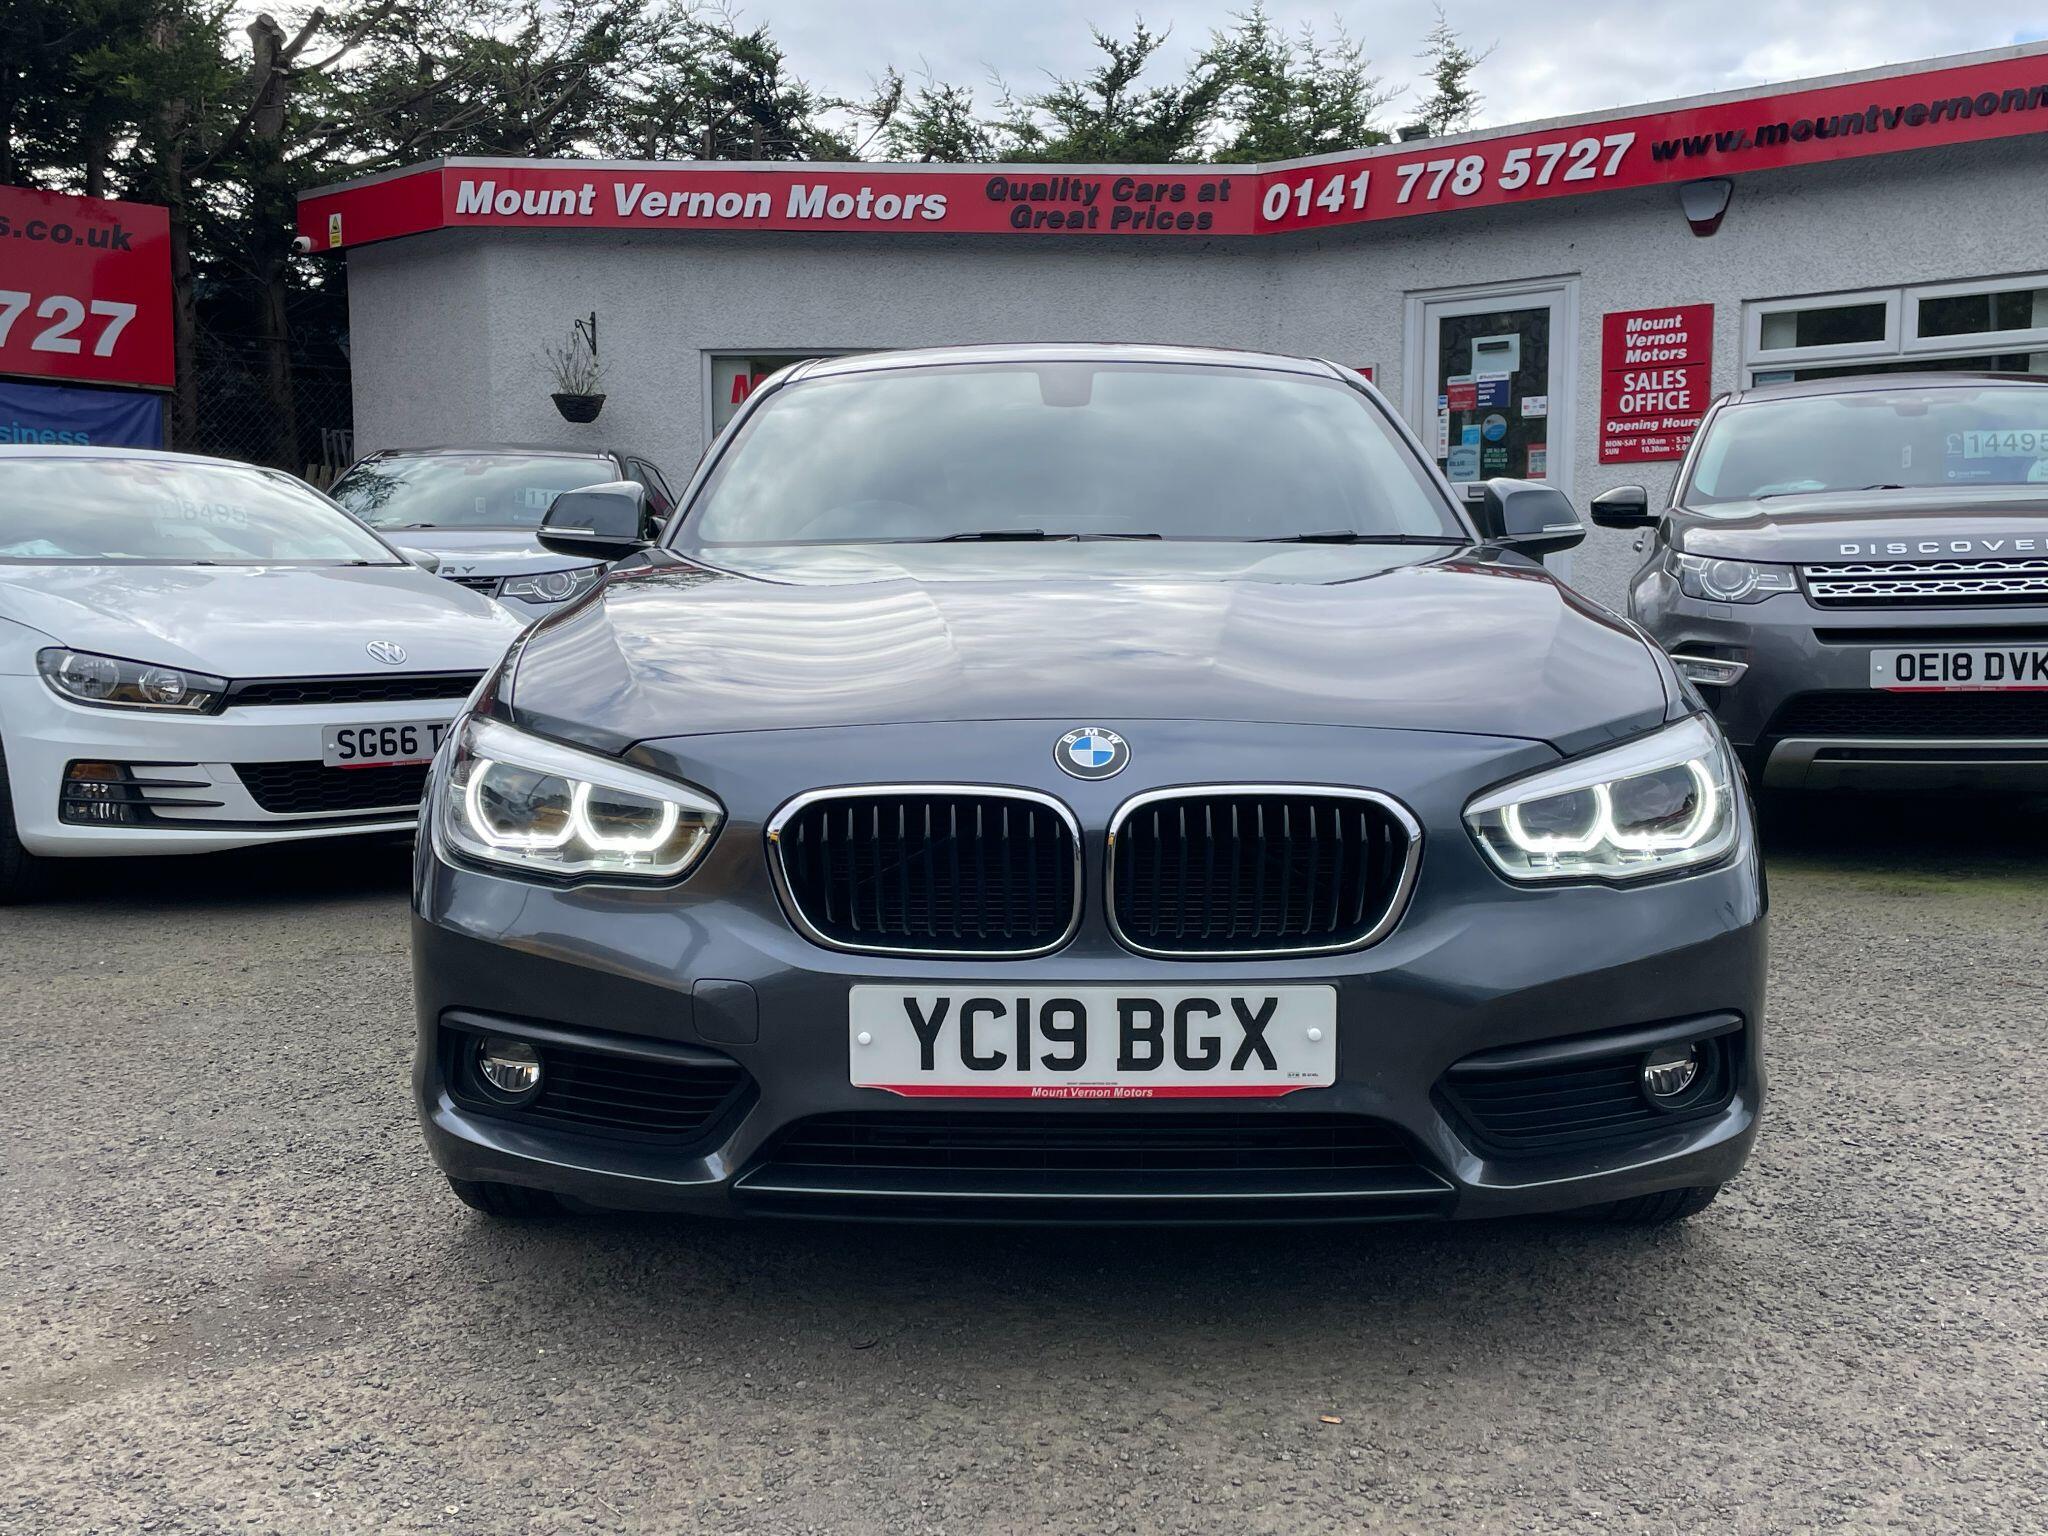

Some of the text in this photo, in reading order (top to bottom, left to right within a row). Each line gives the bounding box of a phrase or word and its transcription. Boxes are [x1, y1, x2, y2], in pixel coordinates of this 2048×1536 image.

[1262, 132, 1636, 222] 0141 778 5727
[455, 180, 948, 221] Mount Vernon Motors
[985, 176, 1231, 206] Quality Cars at
[1010, 204, 1213, 230] Great Prices
[0, 290, 137, 358] 727
[1626, 314, 1683, 332] Mount
[1625, 332, 1688, 348] Vernon
[1625, 348, 1688, 364] Motors
[1623, 369, 1687, 392] SALES
[1619, 390, 1690, 413] OFFICE
[1606, 417, 1701, 433] Opening Hours
[1605, 439, 1638, 448] MON-SAT
[1840, 539, 2048, 555] DISCOVE
[1895, 652, 2048, 682] OE18 DVK
[337, 723, 455, 759] SG66 T
[1062, 728, 1122, 744] BMW
[903, 997, 1279, 1072] YC19 BGX
[1031, 1087, 1153, 1097] Mount Vernon Motors
